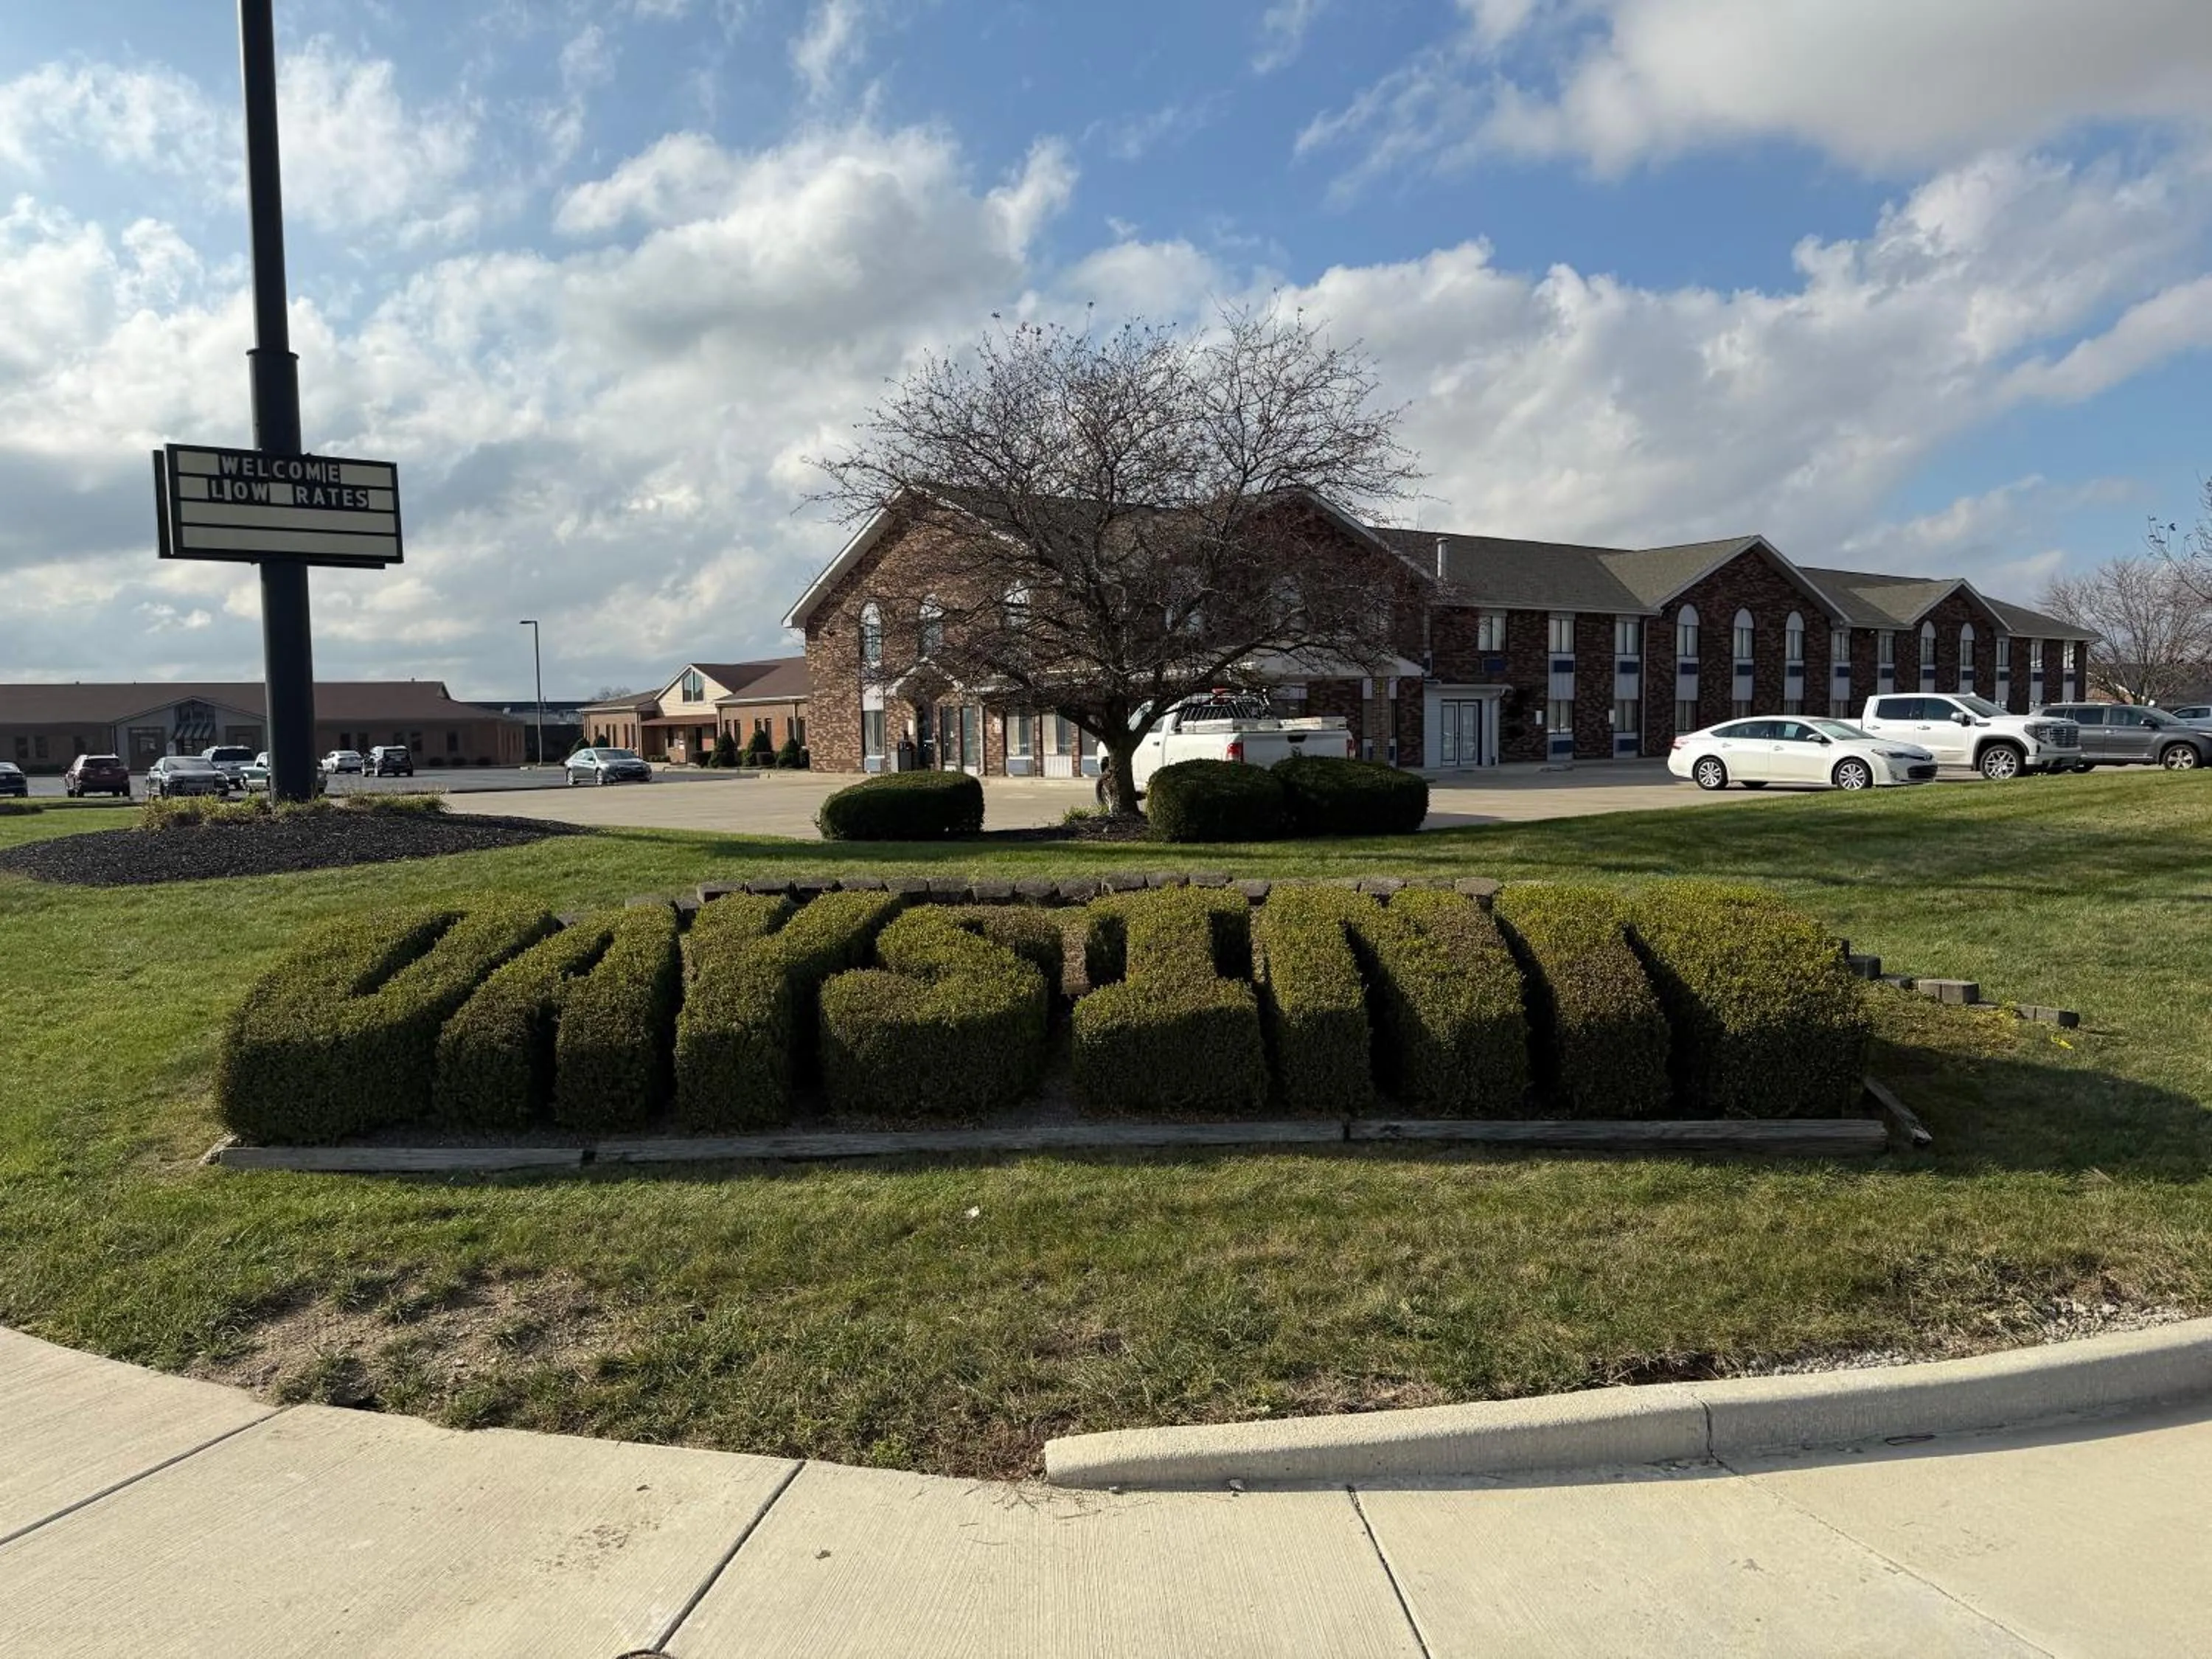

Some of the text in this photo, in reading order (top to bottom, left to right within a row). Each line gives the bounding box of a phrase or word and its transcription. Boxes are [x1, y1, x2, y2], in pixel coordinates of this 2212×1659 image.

[222, 456, 339, 482] WELCOME
[296, 487, 368, 507] RATES
[1071, 882, 1873, 1119] INN
